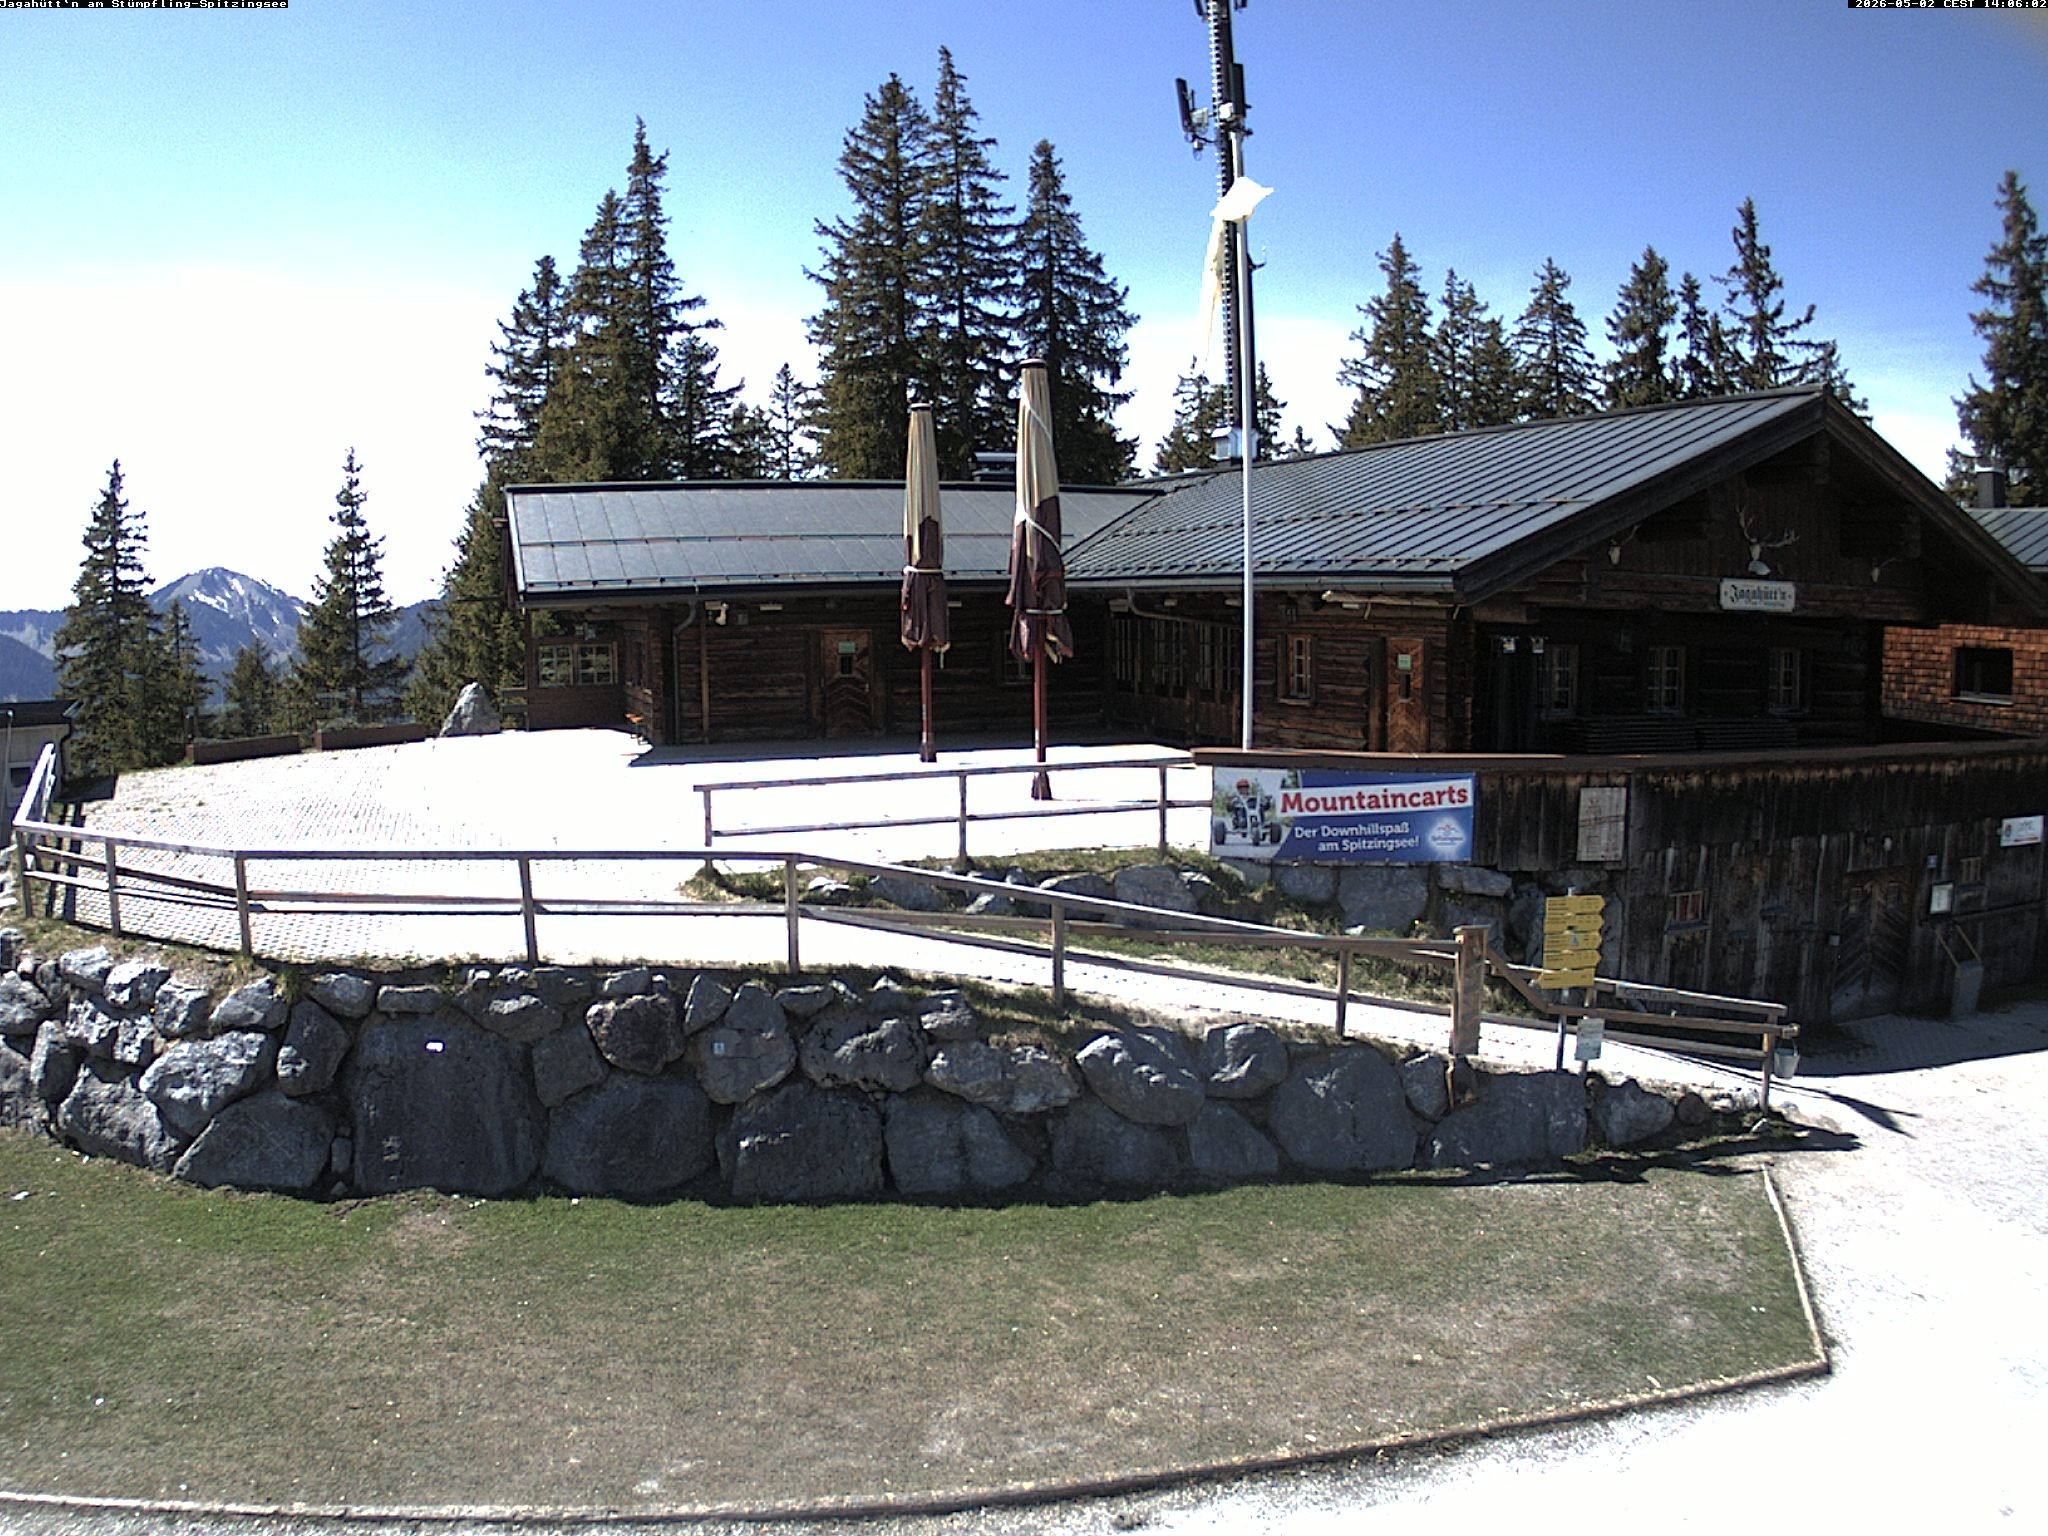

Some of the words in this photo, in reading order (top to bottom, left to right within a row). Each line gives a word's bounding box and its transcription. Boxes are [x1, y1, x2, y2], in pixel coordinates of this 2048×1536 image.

[1280, 785, 1469, 814] Mountaincarts
[1295, 826, 1318, 839] Der
[1321, 822, 1409, 837] Downhillspaß
[1318, 841, 1340, 852] am
[1342, 835, 1420, 853] Spitzingsee!
